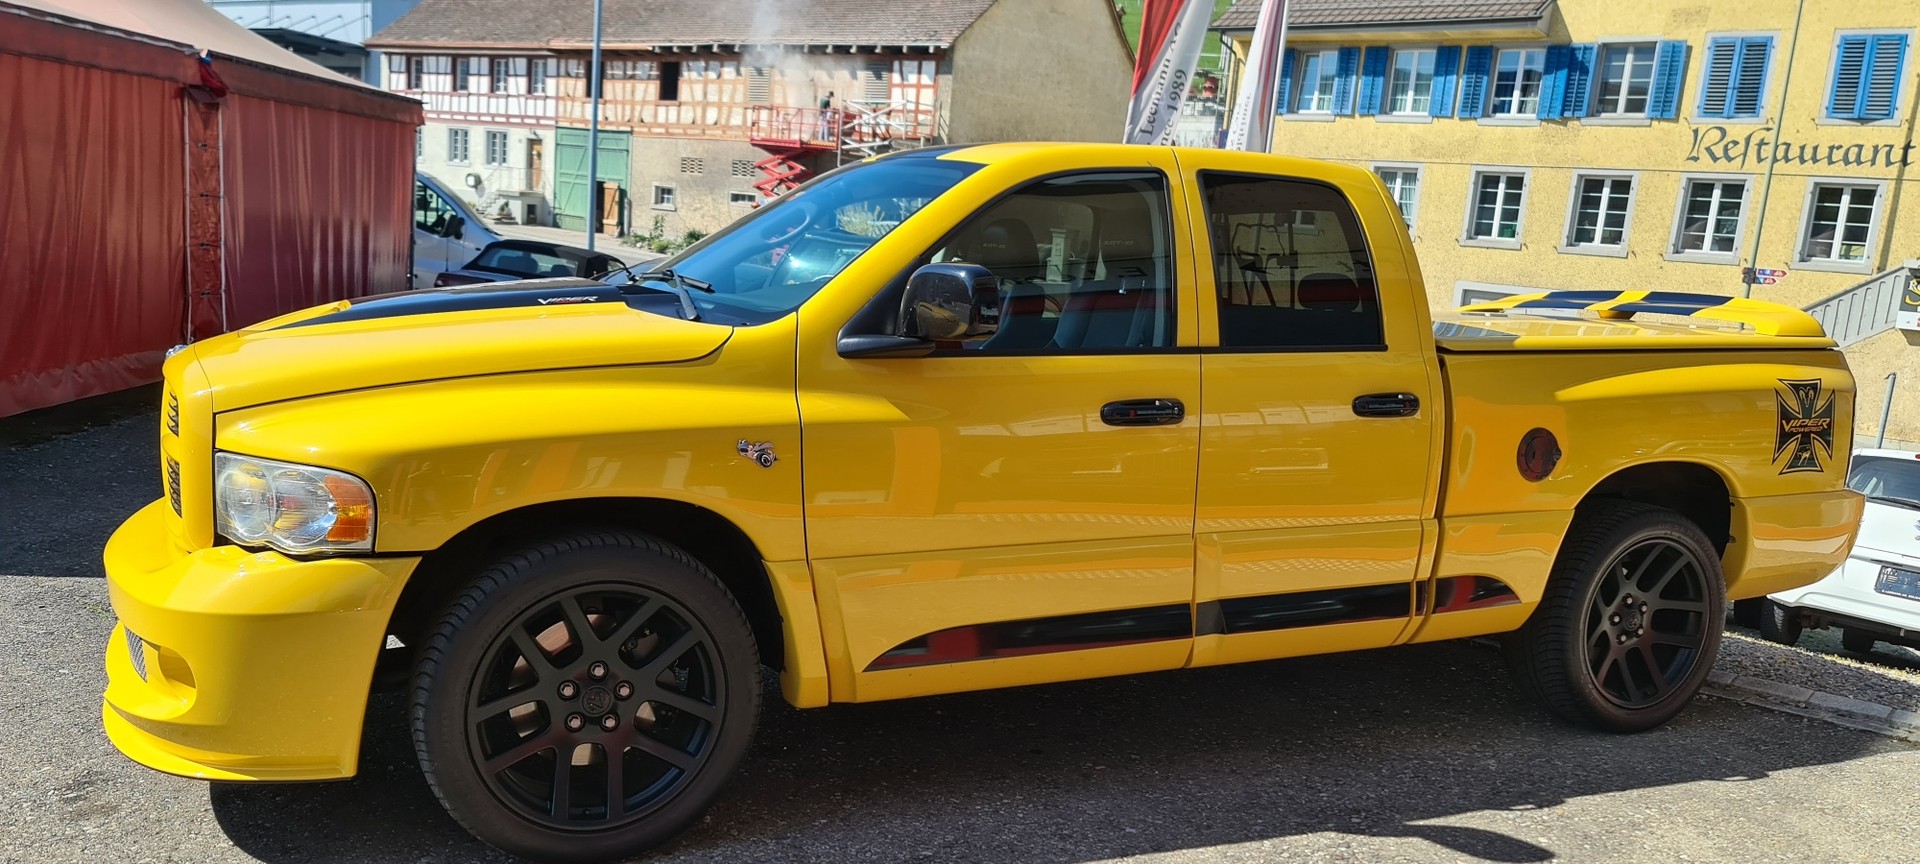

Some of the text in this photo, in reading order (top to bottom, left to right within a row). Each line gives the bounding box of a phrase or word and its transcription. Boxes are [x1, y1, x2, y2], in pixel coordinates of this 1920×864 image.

[1140, 58, 1171, 137] Leemann
[1167, 68, 1188, 112] 1989
[1685, 126, 1916, 169] Restaurant
[1781, 418, 1831, 433] VIPER
